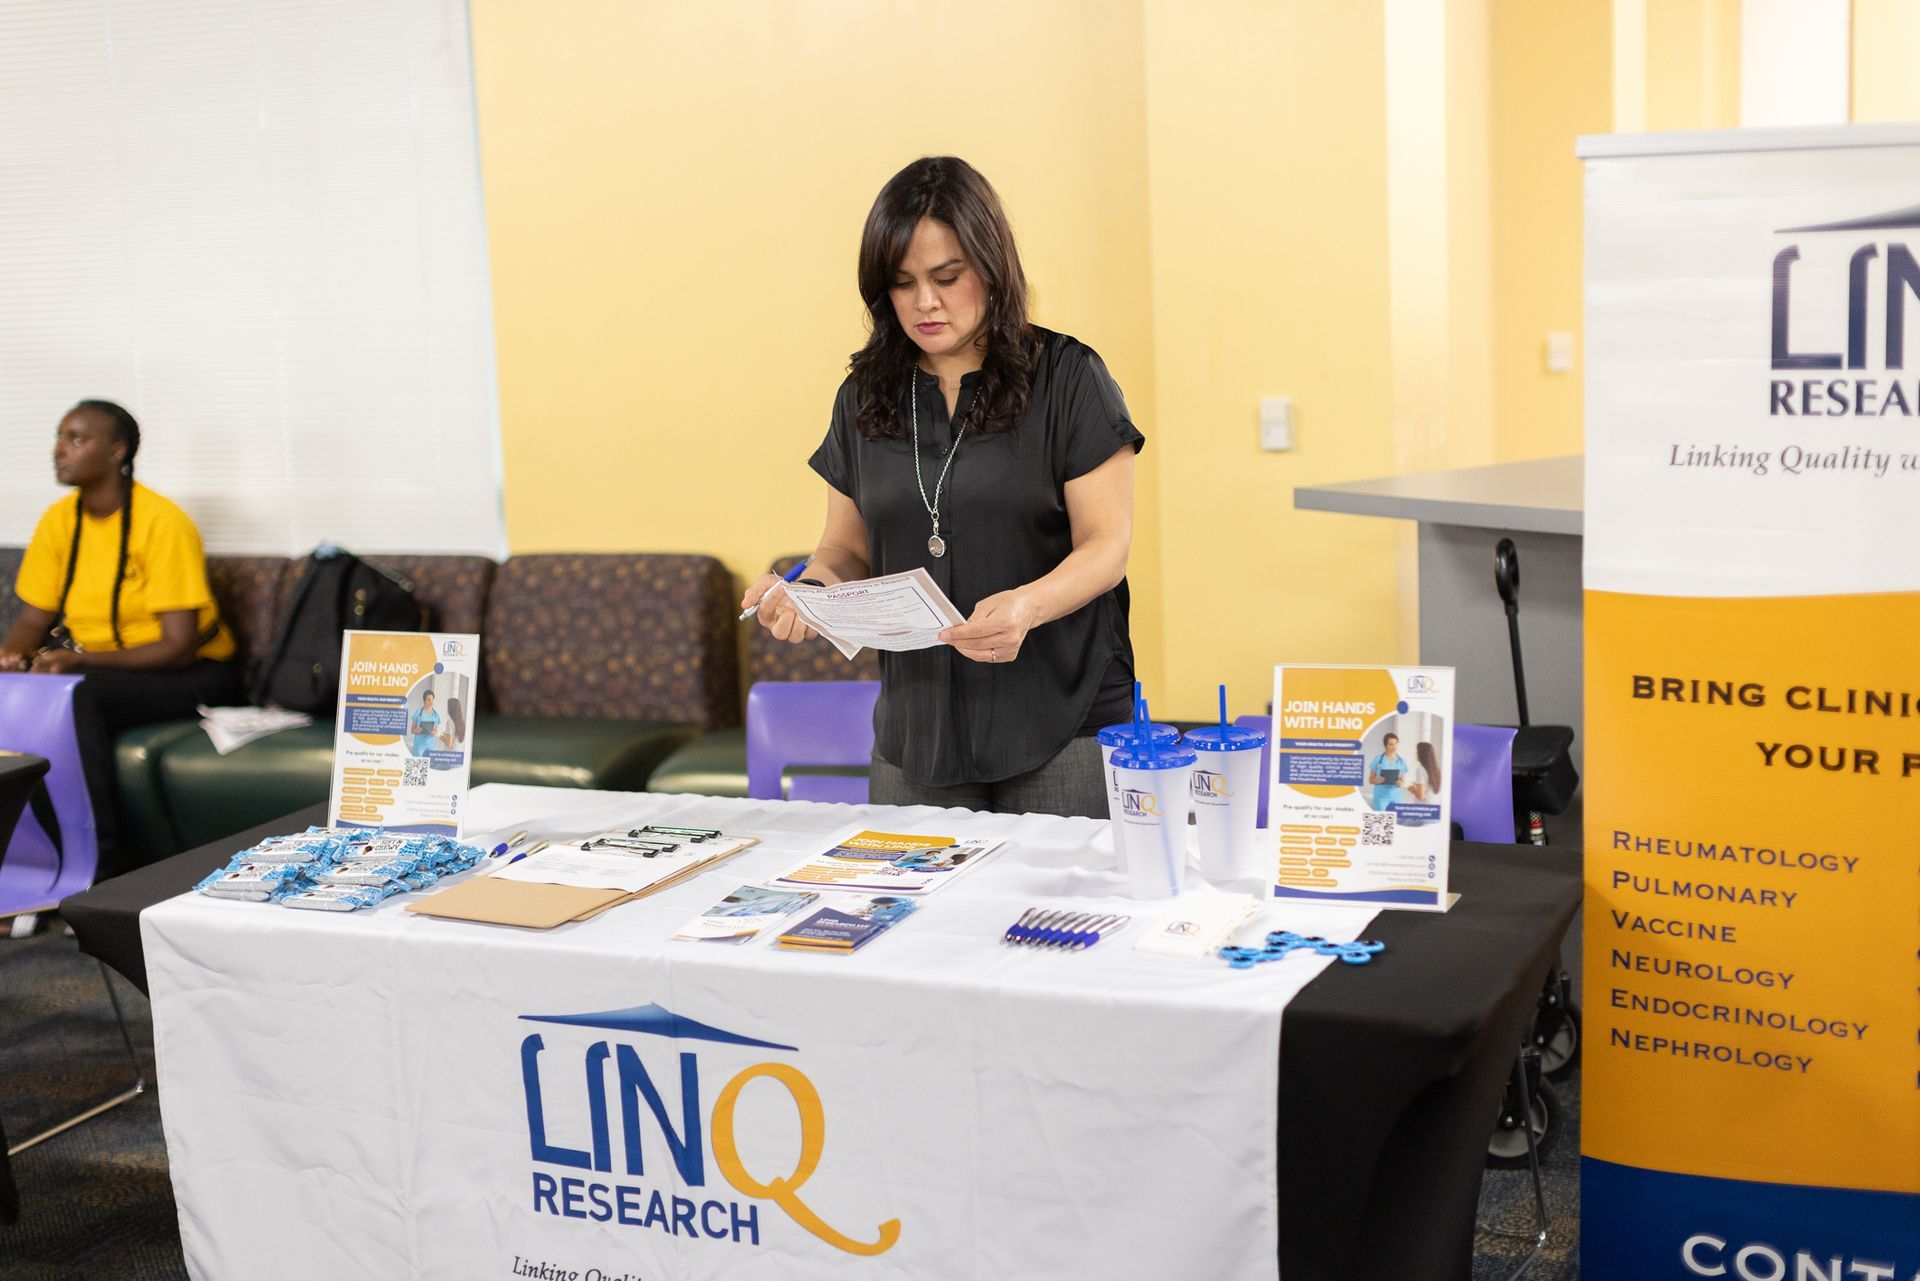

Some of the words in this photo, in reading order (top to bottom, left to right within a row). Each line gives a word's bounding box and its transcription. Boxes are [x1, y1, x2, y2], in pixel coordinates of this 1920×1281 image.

[1770, 379, 1920, 417] RESEA
[1669, 444, 1772, 476] Linking
[1780, 445, 1892, 478] Quality
[827, 589, 869, 600] PASSPORT
[350, 661, 377, 673] JOIN
[379, 662, 419, 674] HANDS
[350, 675, 380, 687] WITH
[382, 676, 409, 687] LINQ
[1284, 701, 1318, 714] JOIN
[1322, 702, 1376, 715] HANDS
[1632, 675, 1766, 708] BRING
[1786, 686, 1920, 718] CLINI
[1284, 716, 1324, 730] WITH
[1327, 717, 1363, 730] LINQ
[1756, 742, 1881, 775] YOUR
[1193, 773, 1235, 798] LINQ
[1122, 791, 1165, 816] LINQ
[848, 840, 884, 849] WITH
[853, 837, 884, 846] JOIN
[886, 840, 932, 848] HANDS
[1613, 830, 1860, 874] RHEUMATOLOGY
[1612, 870, 1798, 909] PULMONARY
[1611, 909, 1737, 943] VACCINE
[1611, 949, 1795, 990] NEUROLOGY
[1611, 988, 1869, 1041] ENDOCRINOLOGY
[1610, 1028, 1813, 1074] NEPHROLOGY
[520, 1033, 902, 1257] LINQ
[531, 1172, 761, 1247] RESEARCH
[1683, 1235, 1920, 1281] CONT
